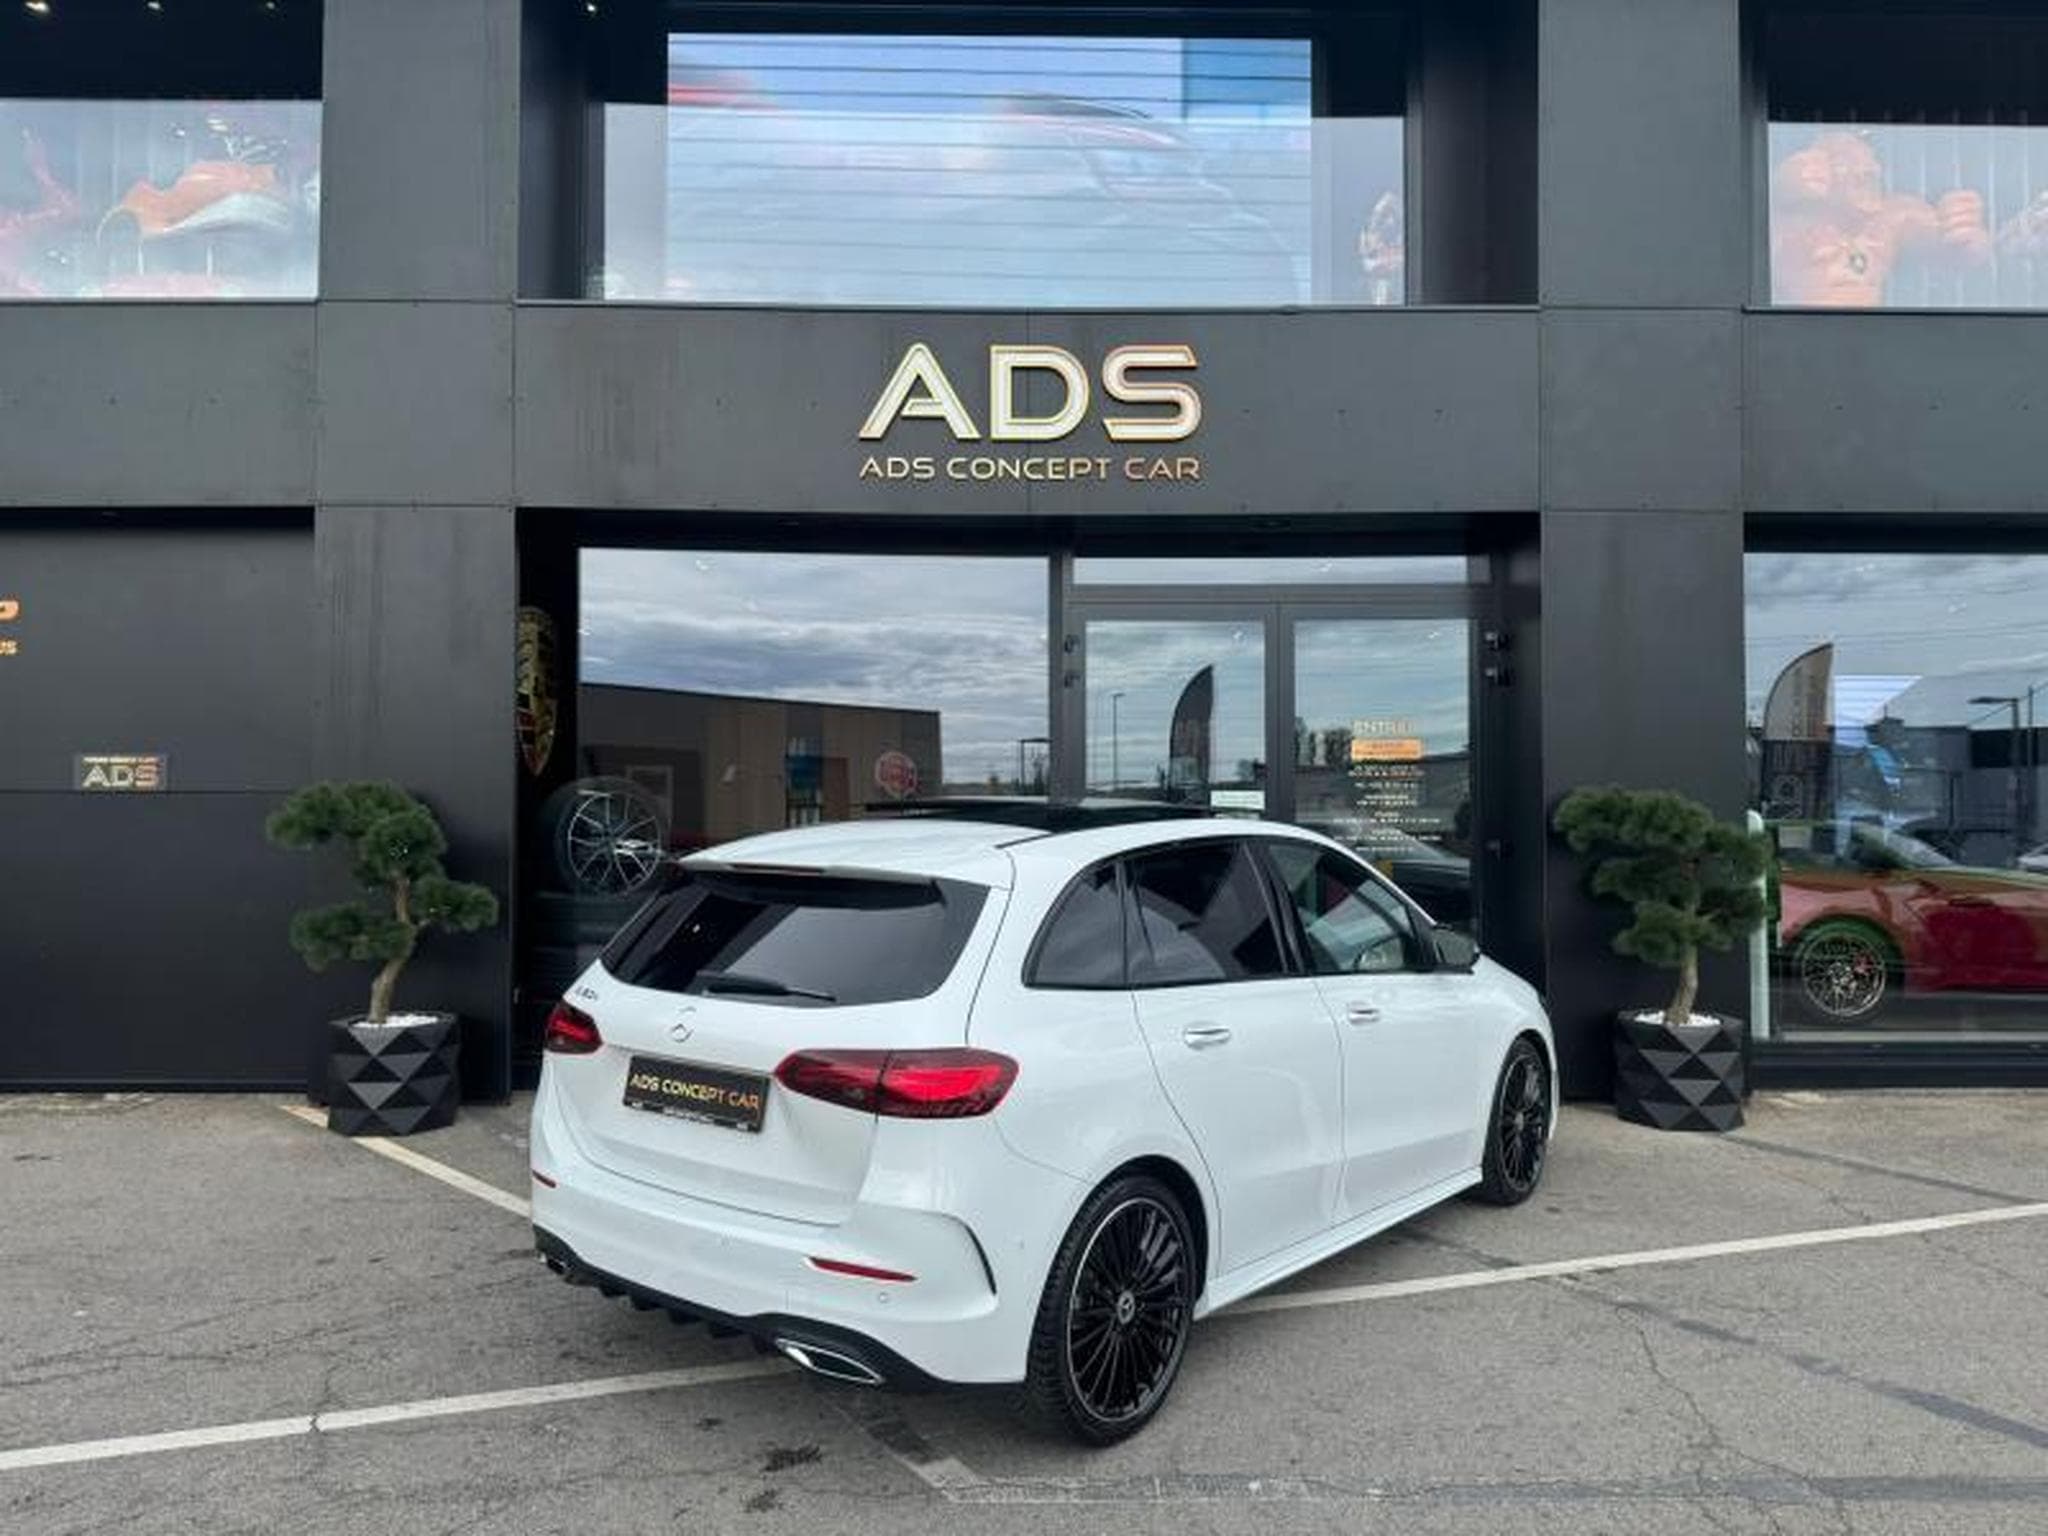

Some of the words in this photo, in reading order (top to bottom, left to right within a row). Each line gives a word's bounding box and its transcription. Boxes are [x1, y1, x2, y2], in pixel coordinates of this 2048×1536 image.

[859, 342, 1201, 441] ADS
[859, 457, 935, 480] ADS
[946, 457, 1112, 481] CONCEPT
[1124, 457, 1200, 481] CAR
[82, 764, 159, 788] ADS
[629, 1073, 660, 1092] ADS
[661, 1079, 727, 1104] CONCEPT
[727, 1091, 760, 1110] CAR
